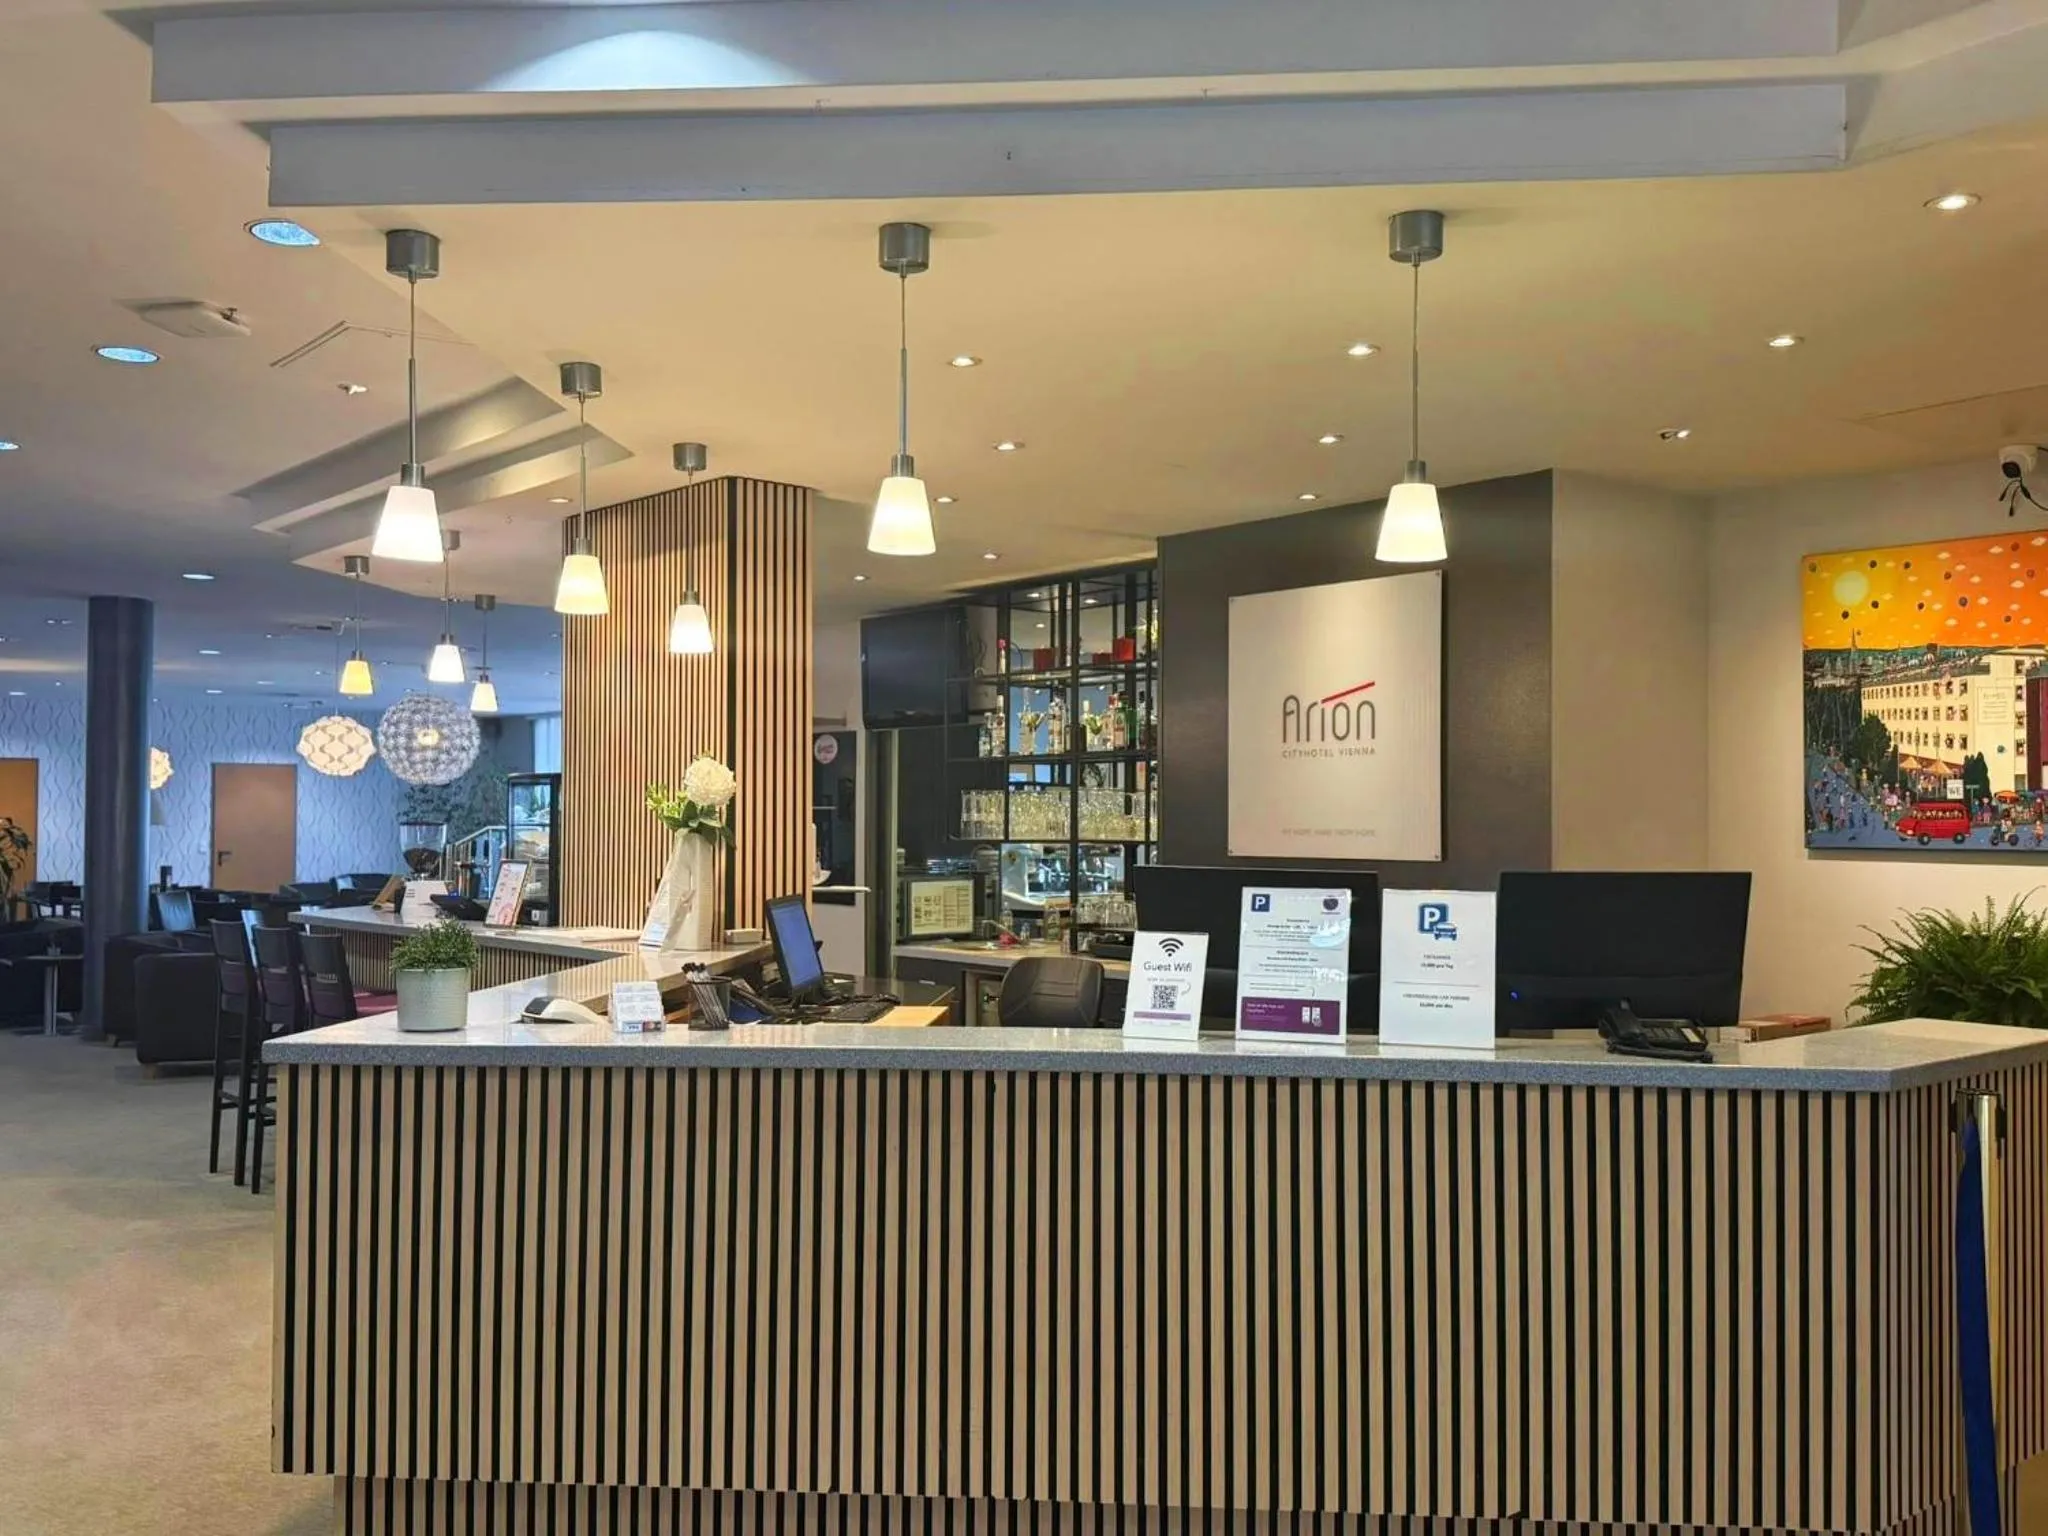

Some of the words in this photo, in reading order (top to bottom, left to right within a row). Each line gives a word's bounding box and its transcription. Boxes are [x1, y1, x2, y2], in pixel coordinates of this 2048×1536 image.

[1282, 694, 1375, 743] Arion
[1281, 748, 1335, 759] CITYHOTEL
[1337, 746, 1376, 757] VIENNA
[1423, 907, 1441, 931] P
[1143, 960, 1171, 972] Guest
